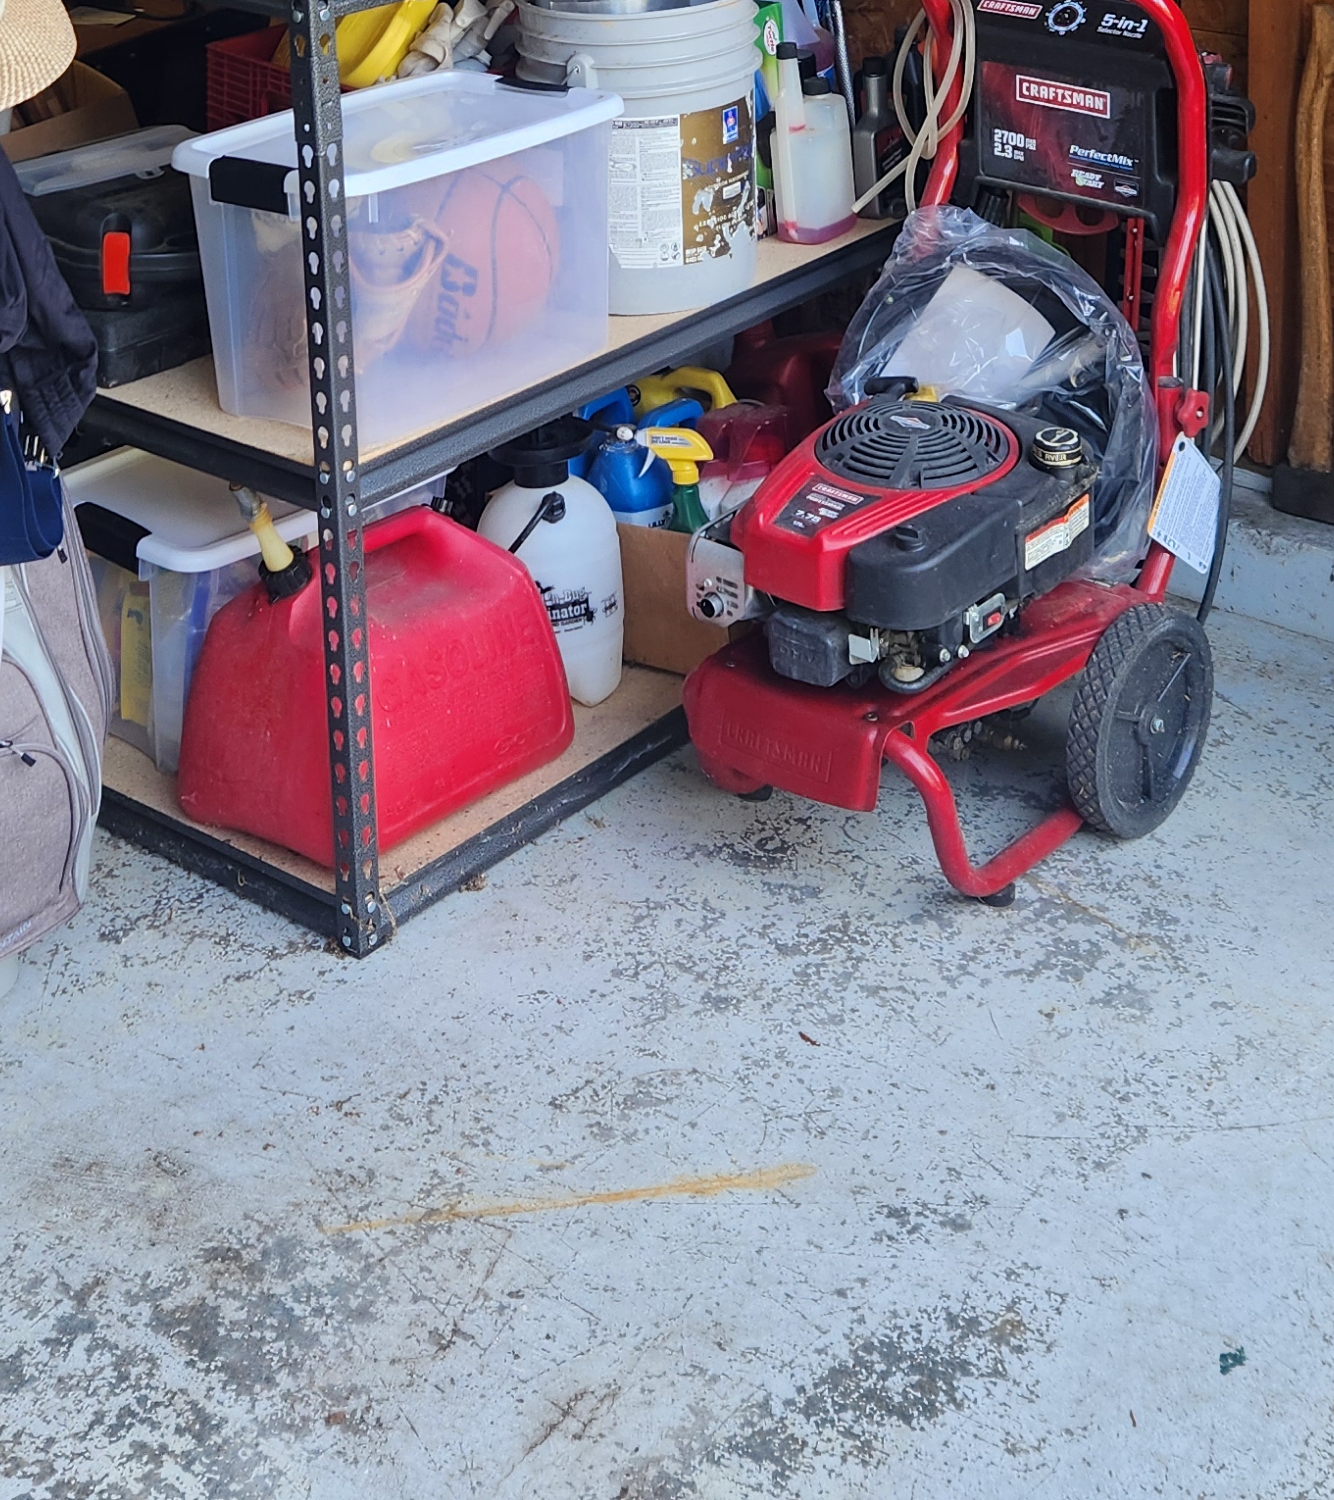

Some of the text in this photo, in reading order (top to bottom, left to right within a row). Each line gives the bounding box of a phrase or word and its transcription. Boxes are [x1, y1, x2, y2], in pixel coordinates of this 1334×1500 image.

[983, 0, 1038, 16] CRAFTSMAN
[1101, 13, 1148, 33] 5-in-1
[1022, 81, 1105, 111] CRAFTSMAN
[994, 128, 1025, 148] 2700
[994, 142, 1013, 160] 2.3
